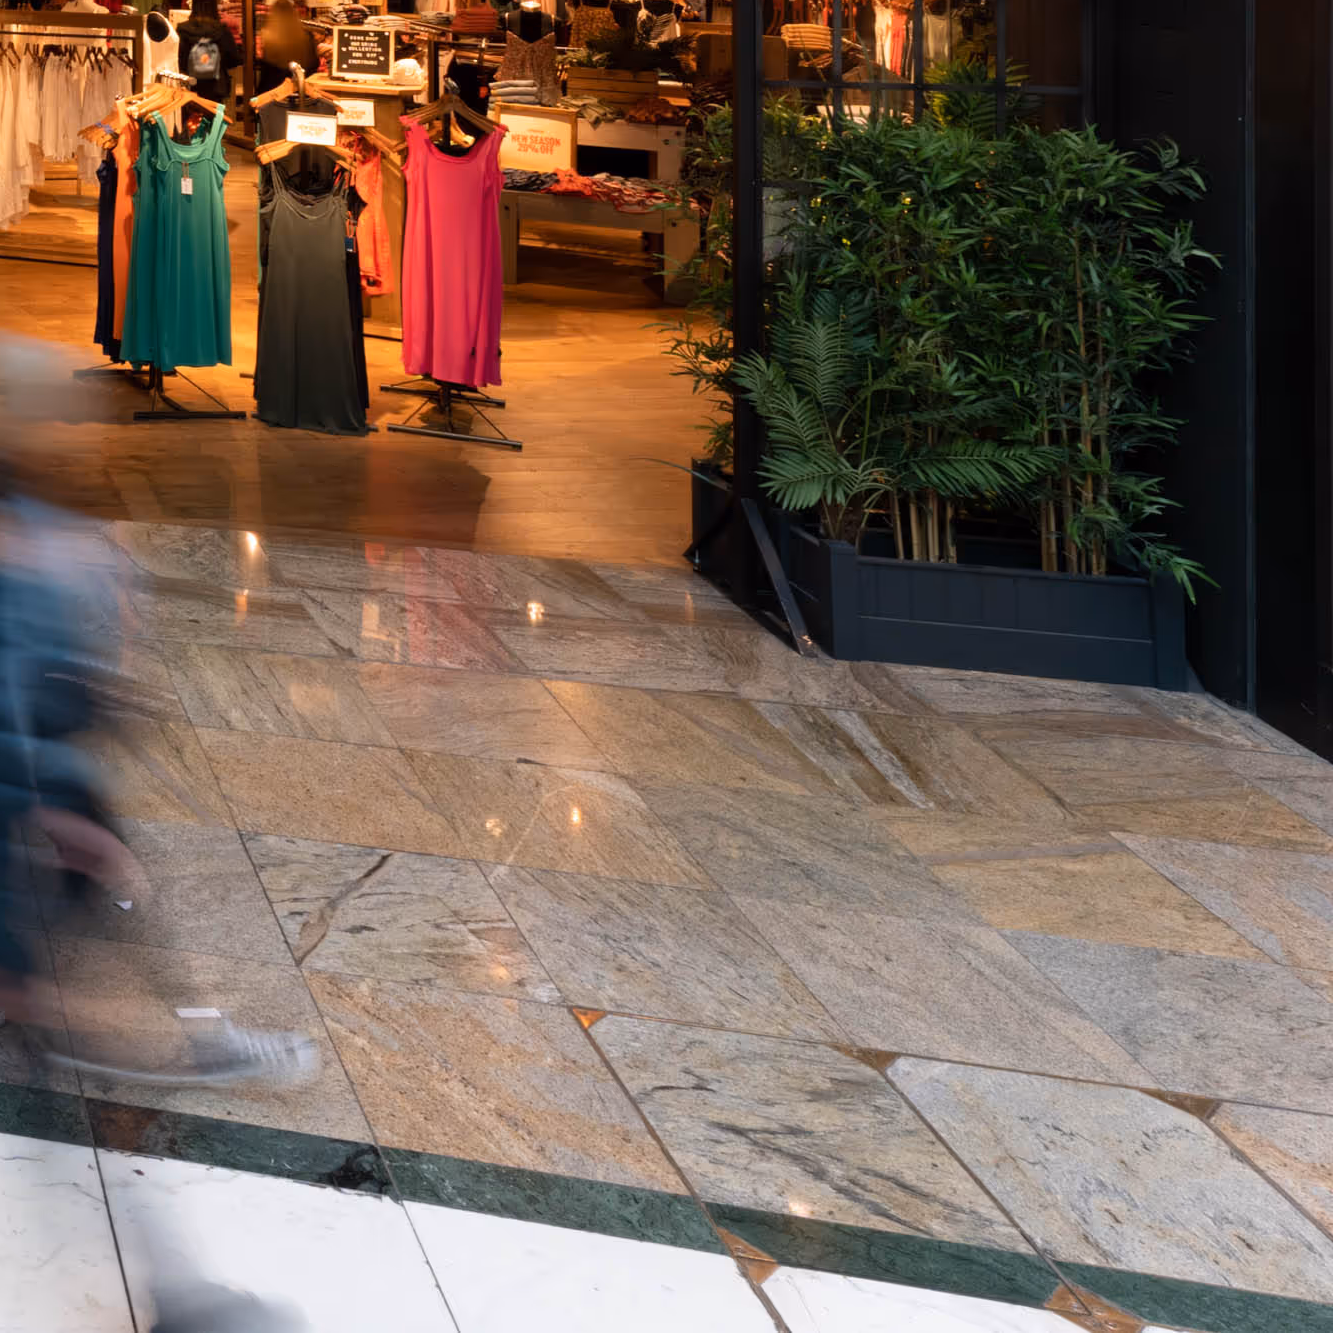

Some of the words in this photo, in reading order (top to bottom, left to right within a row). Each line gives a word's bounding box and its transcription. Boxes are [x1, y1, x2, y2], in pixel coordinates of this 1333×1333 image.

[511, 134, 528, 143] NEW
[530, 135, 561, 147] SEASON
[540, 145, 554, 155] OFF
